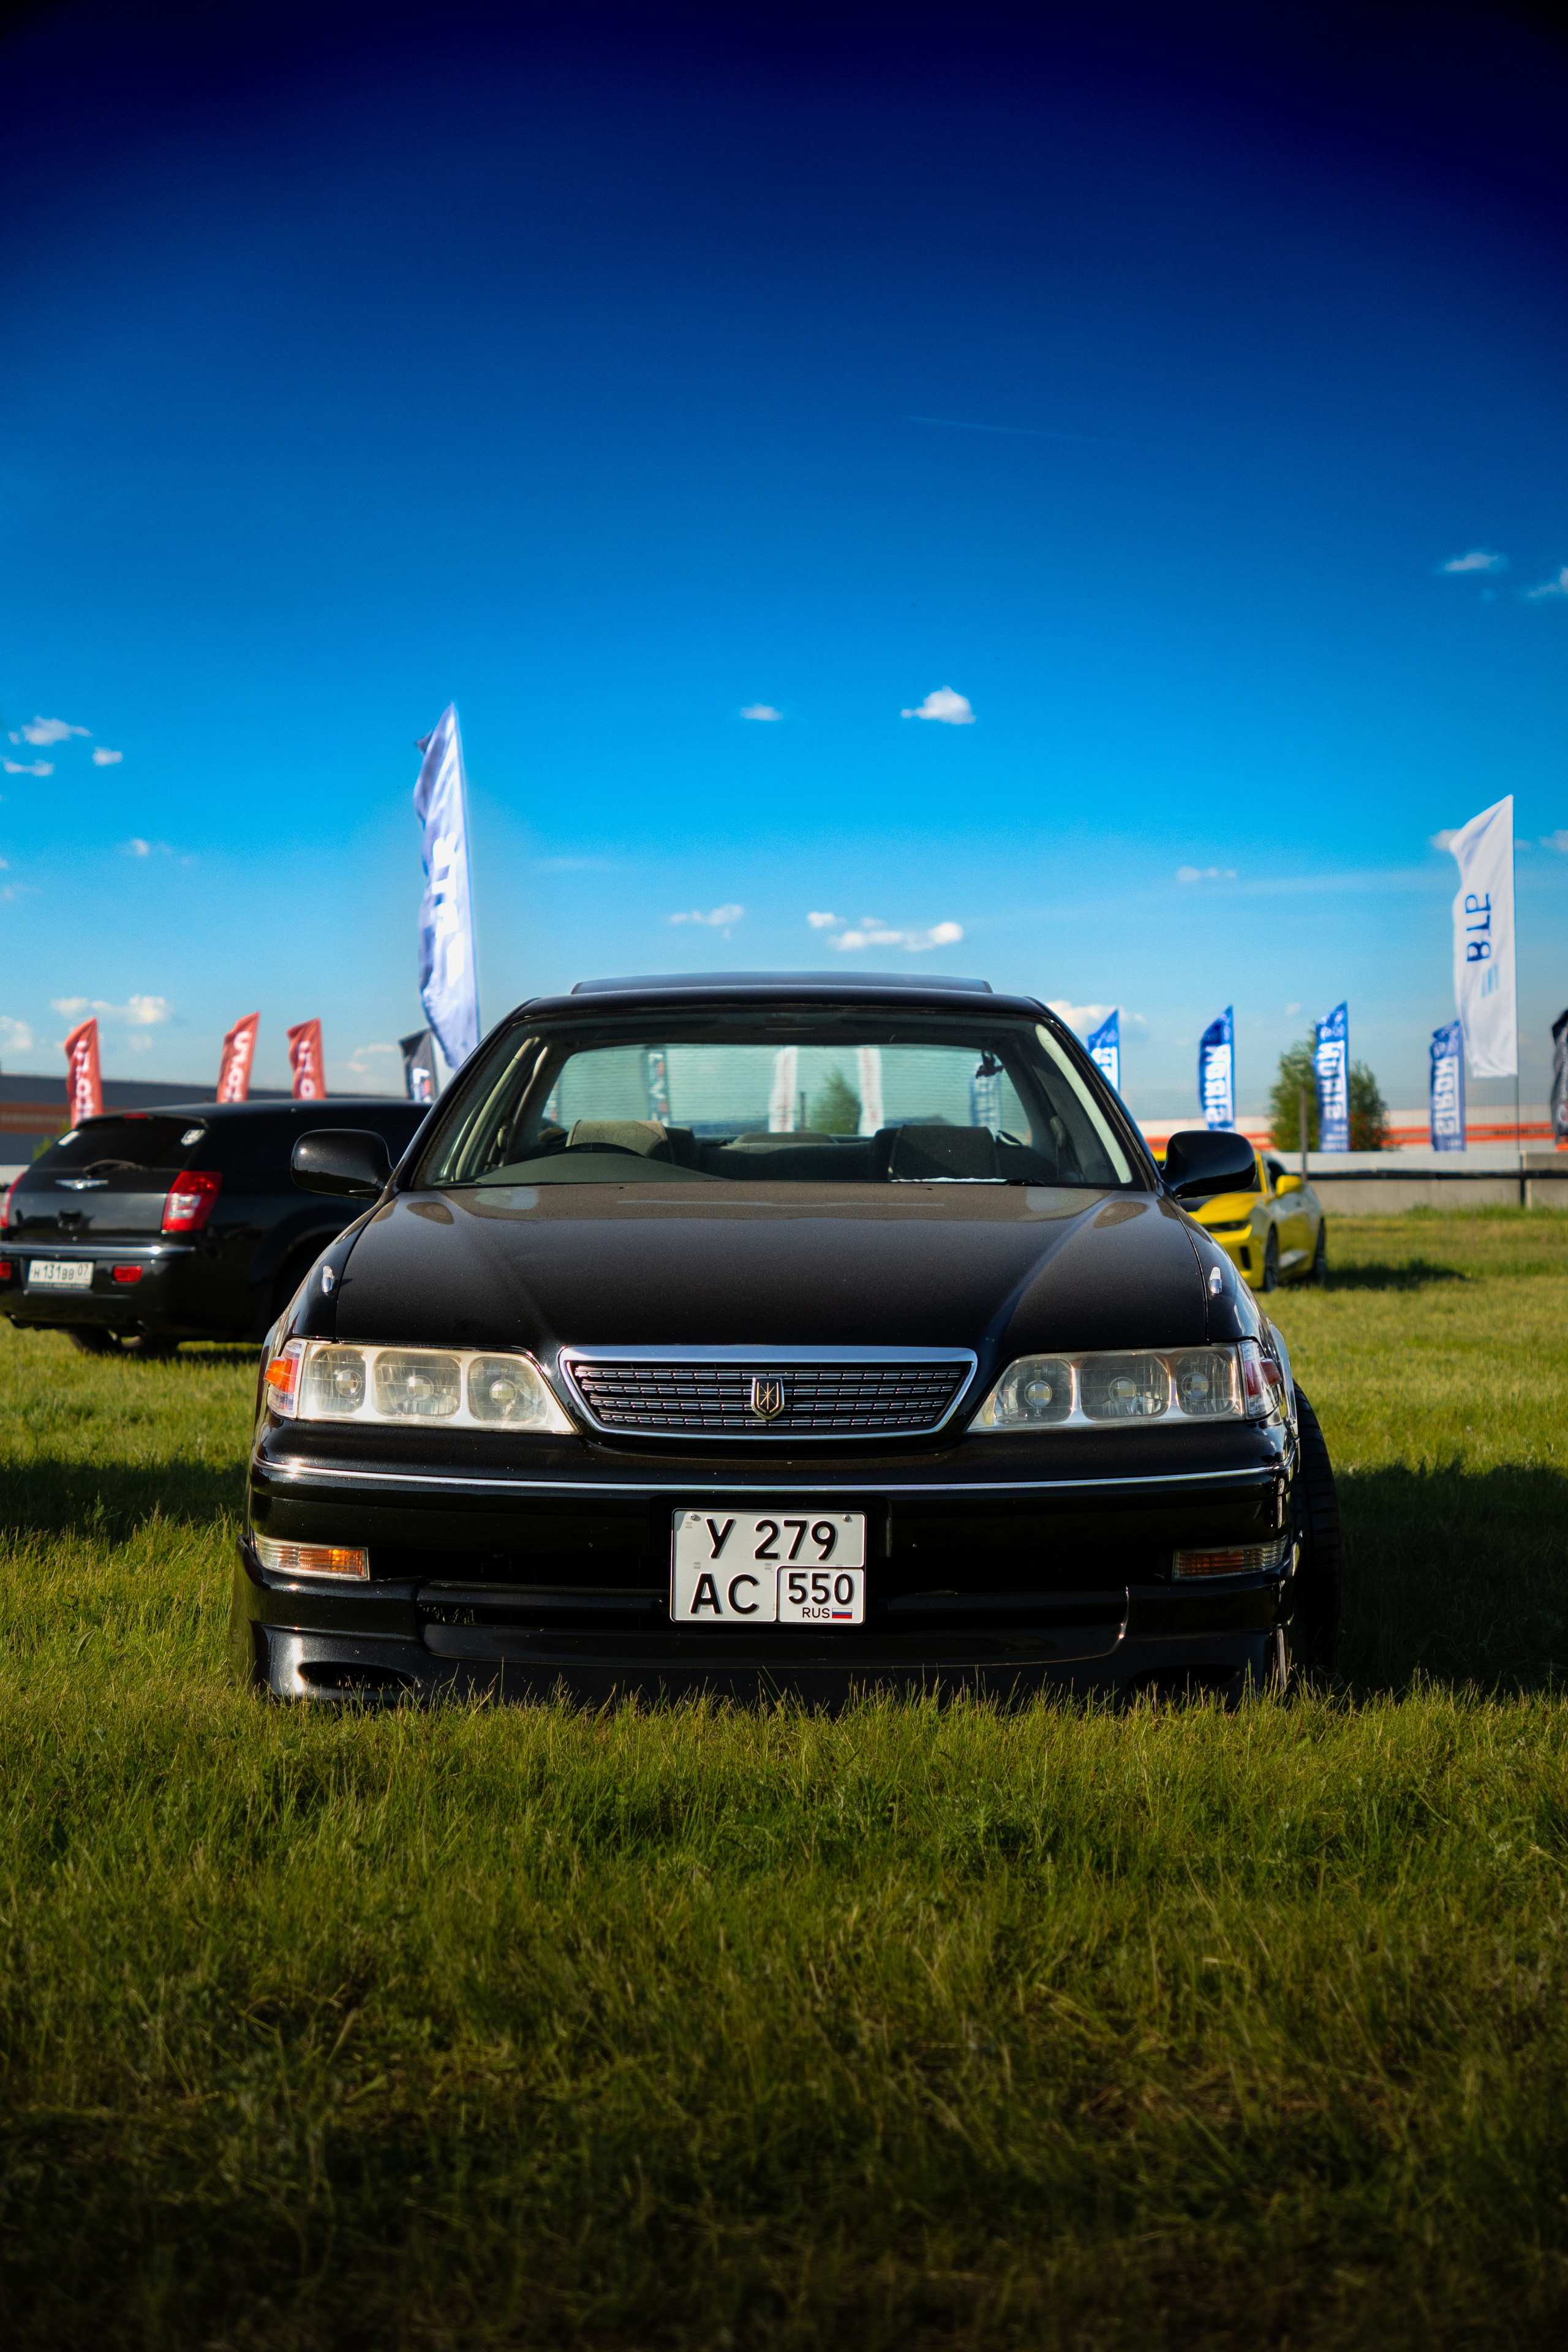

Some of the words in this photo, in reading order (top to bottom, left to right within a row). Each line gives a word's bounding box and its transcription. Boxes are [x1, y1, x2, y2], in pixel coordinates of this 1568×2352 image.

[754, 1519, 837, 1560] 279
[788, 1572, 853, 1605] 550
[802, 1607, 830, 1618] RUS
